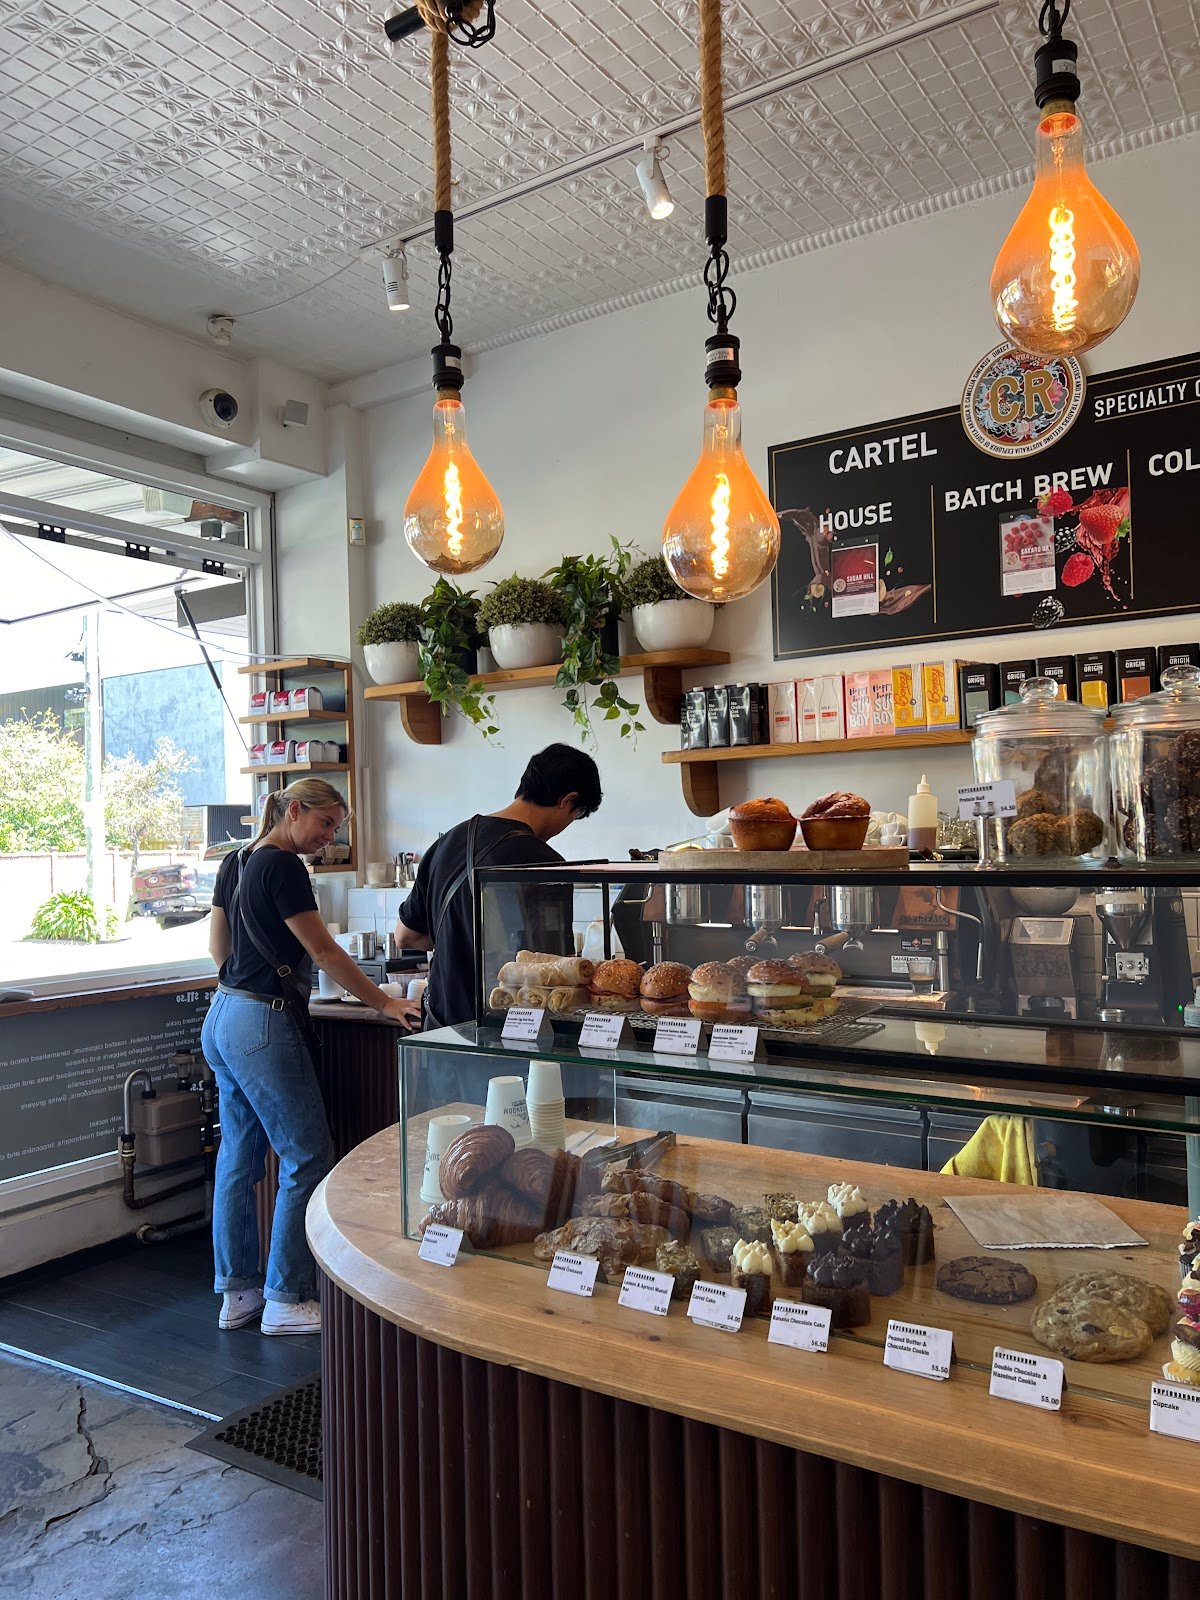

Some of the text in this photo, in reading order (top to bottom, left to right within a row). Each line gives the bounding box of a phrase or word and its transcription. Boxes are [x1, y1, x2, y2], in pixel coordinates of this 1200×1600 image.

[992, 343, 1010, 357] DIRECT
[965, 379, 976, 404] CAMELLIA
[990, 369, 1054, 424] CR
[1094, 382, 1187, 418] SPECIALTY
[1062, 403, 1080, 427] TRADERS
[1043, 427, 1064, 445] GEELONG
[828, 431, 938, 475] CARTEL
[989, 444, 1014, 455] EXPLORER
[1015, 441, 1043, 455] AUSTRALIA
[1148, 448, 1200, 476] COL
[944, 462, 1113, 512] BATCH BREW
[819, 502, 893, 534] HOUSE
[846, 572, 874, 583] SUGAR HILL
[1125, 660, 1145, 669] ORIGIN
[1169, 656, 1190, 665] ORIGIN
[1044, 668, 1063, 676] ORIGIN
[1083, 664, 1103, 673] ORIGIN
[967, 676, 985, 684] ORIGIN
[1007, 672, 1025, 680] ORIGIN
[623, 1279, 637, 1287] Lemon
[641, 1284, 655, 1292] Apricot
[692, 1293, 716, 1304] Carrot Cake
[727, 1314, 741, 1323] $4.00
[772, 1315, 826, 1329] Banana Chocolate Cake
[889, 1324, 927, 1337] SUPERRANDOM
[811, 1340, 827, 1348] $6.50
[887, 1334, 906, 1344] Peanut
[906, 1337, 922, 1347] Butter
[887, 1342, 930, 1356] Chocolate Cookie
[995, 1351, 1037, 1366] SUPERRANDOM
[931, 1364, 949, 1374] $5.50
[994, 1362, 1013, 1373] Double
[1014, 1366, 1042, 1379] Chocolate
[993, 1370, 1037, 1387] Hazelnut Cookie
[1041, 1395, 1060, 1405] $5.00
[1152, 1399, 1180, 1411] Cupcake
